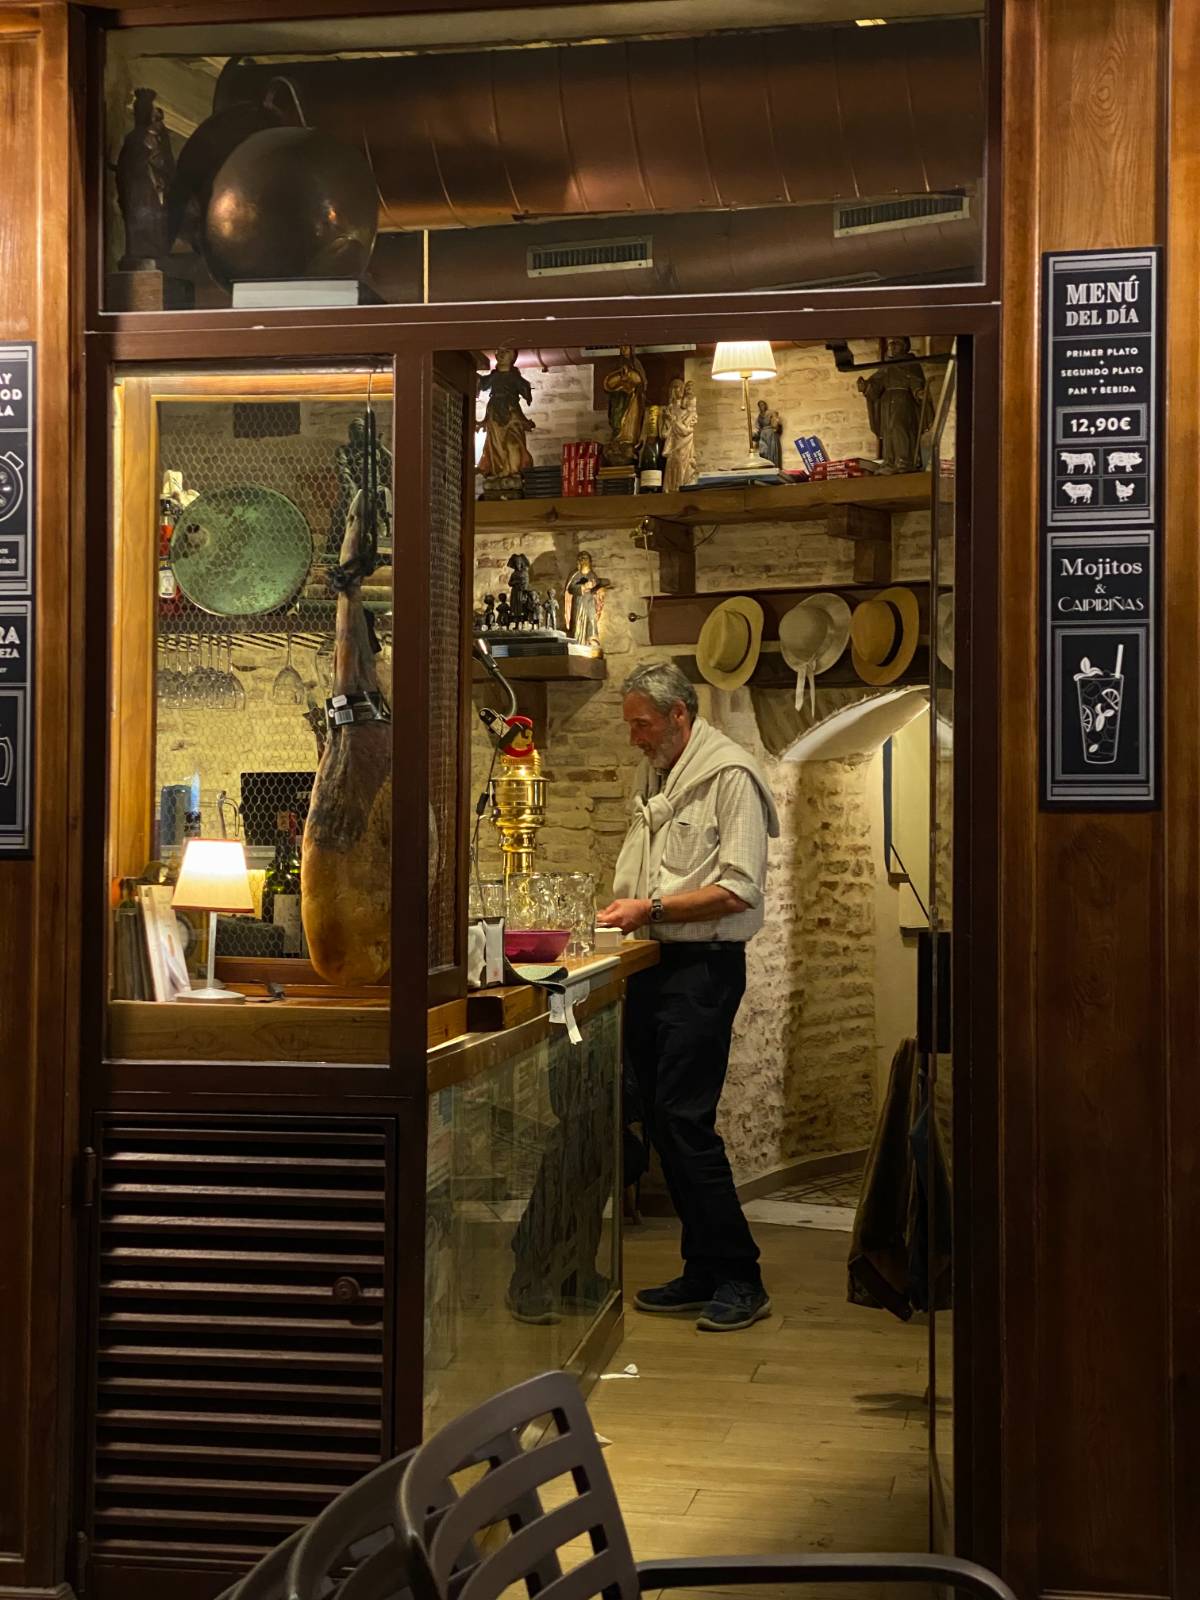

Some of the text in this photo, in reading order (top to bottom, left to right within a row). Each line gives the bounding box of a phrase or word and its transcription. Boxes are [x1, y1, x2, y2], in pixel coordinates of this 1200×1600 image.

[1066, 275, 1140, 305] MENÚ
[1065, 304, 1139, 327] DEL DÍA
[1066, 347, 1139, 358] PRIMER PLATO
[1061, 366, 1144, 377] SEGUNDO PLATO
[1068, 385, 1136, 396] PAN Y BEBIDA
[1070, 416, 1131, 435] 12,90€
[1060, 558, 1143, 580] Mojitos
[1094, 583, 1107, 594] &
